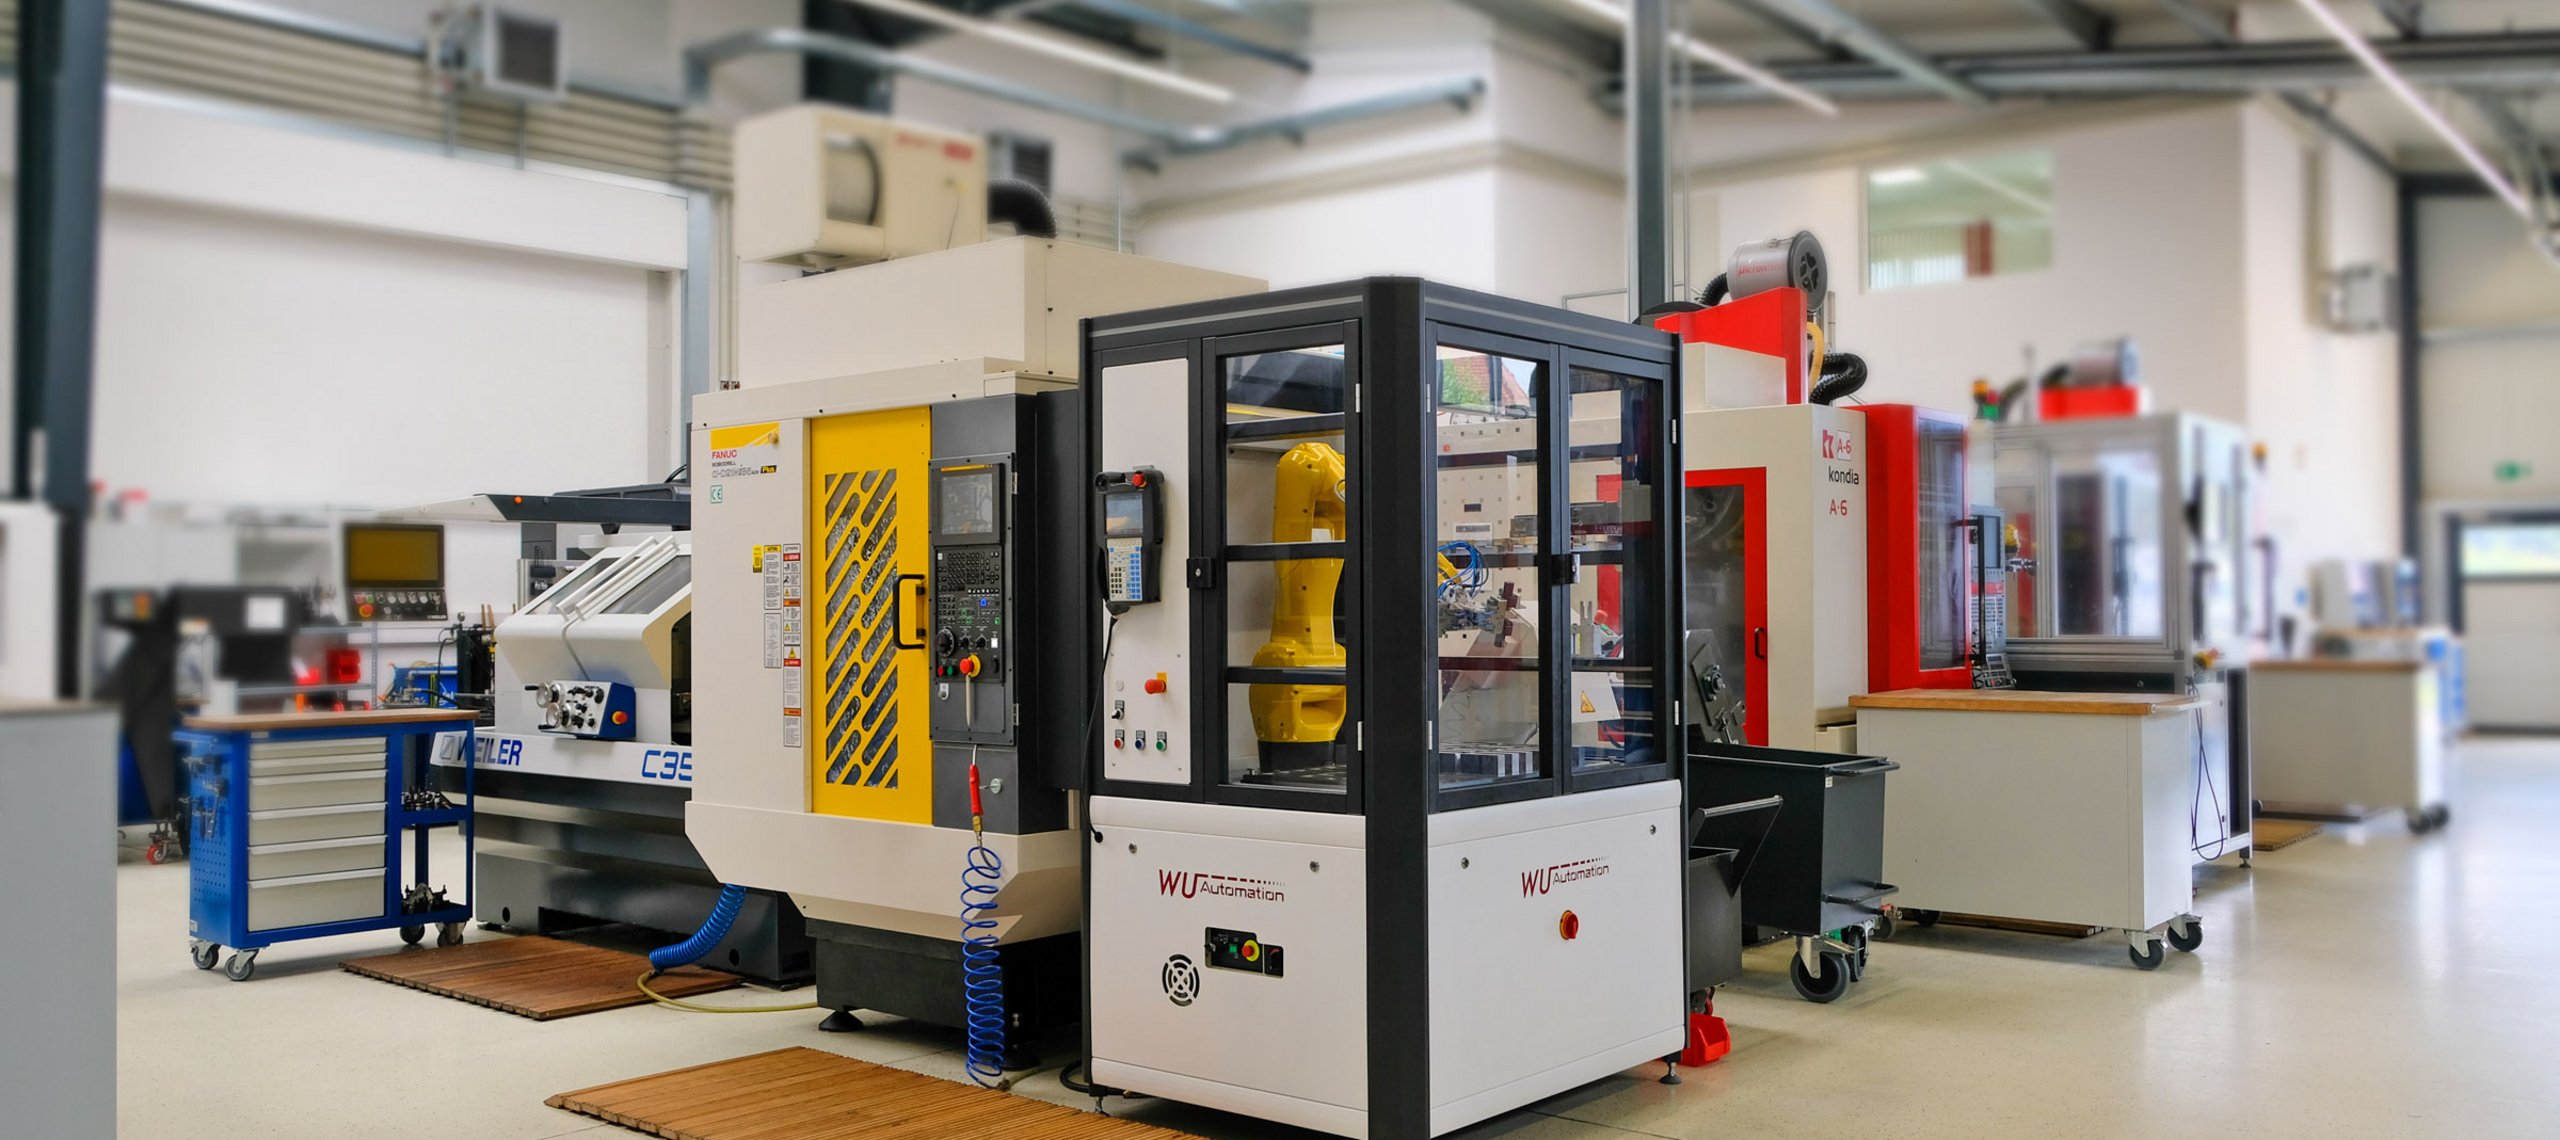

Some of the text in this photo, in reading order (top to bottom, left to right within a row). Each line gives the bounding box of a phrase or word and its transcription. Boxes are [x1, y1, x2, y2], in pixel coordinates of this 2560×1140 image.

[712, 449, 737, 459] FANUC
[1837, 438, 1852, 454] A-6
[1828, 465, 1860, 485] kondia
[1159, 868, 1285, 903] WU Automation
[1521, 864, 1610, 898] WU Automation
